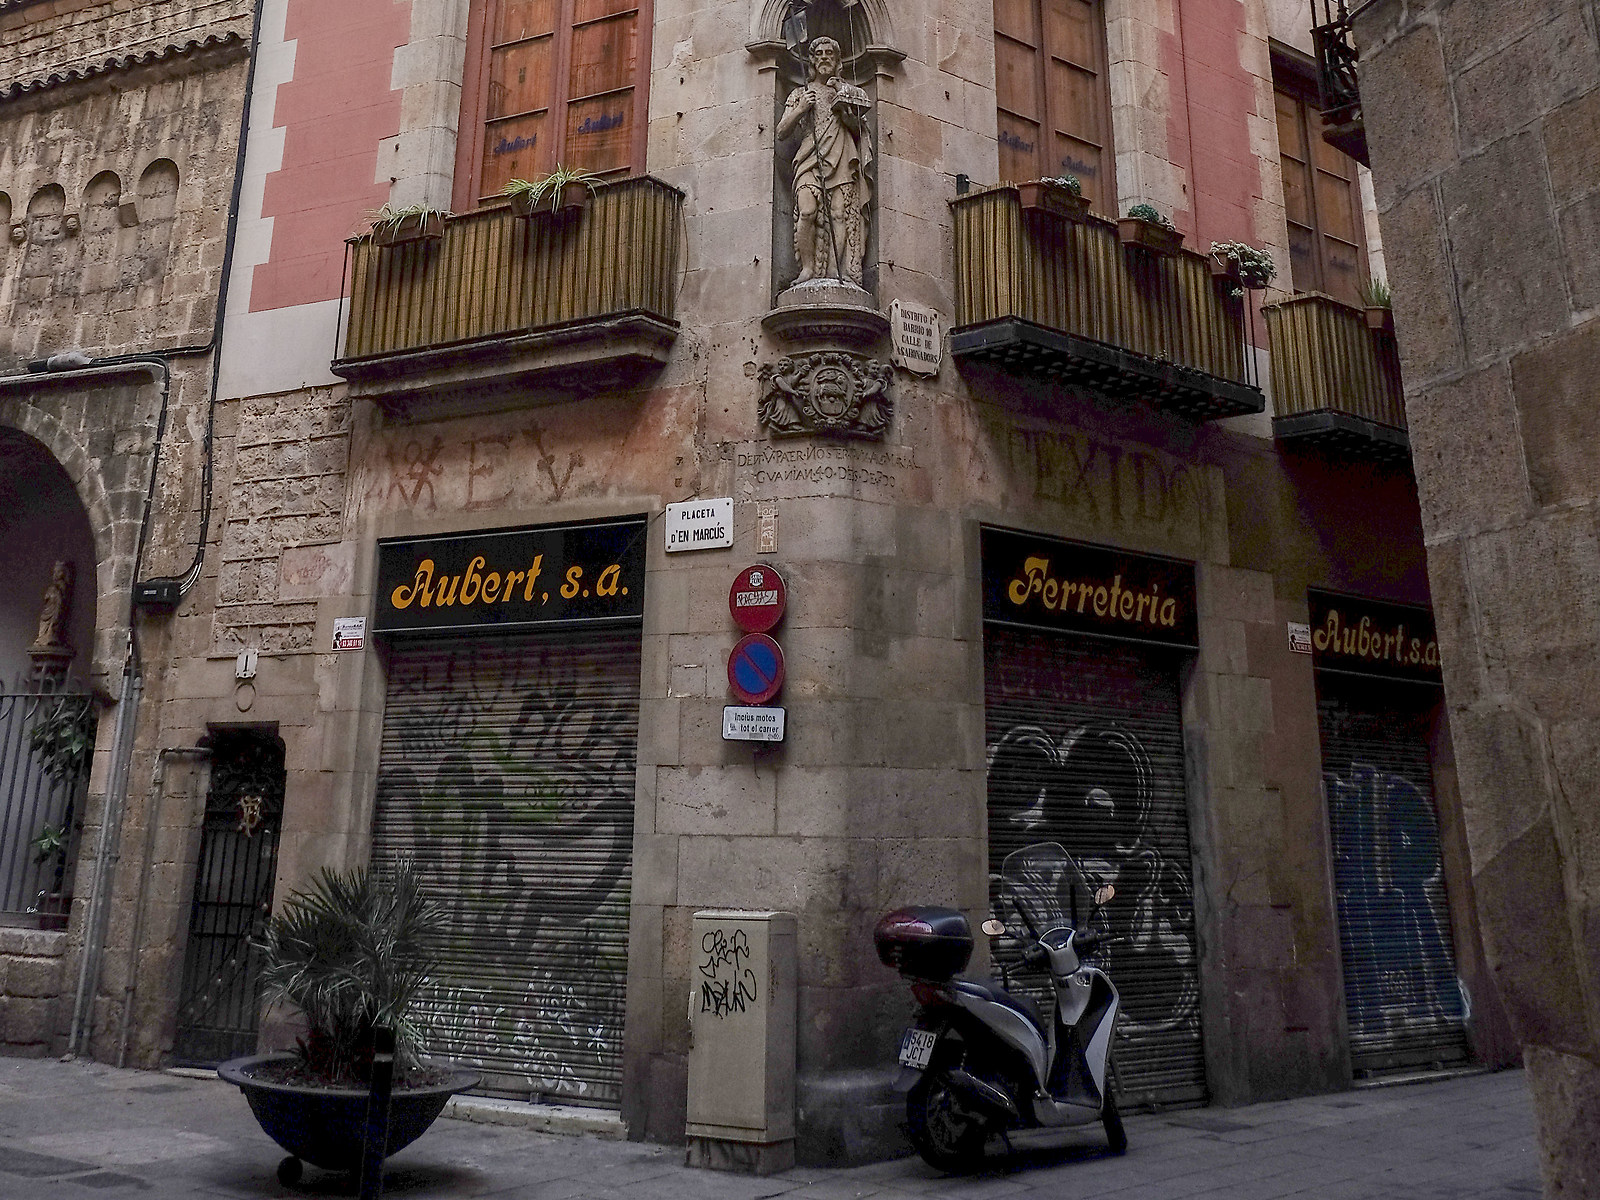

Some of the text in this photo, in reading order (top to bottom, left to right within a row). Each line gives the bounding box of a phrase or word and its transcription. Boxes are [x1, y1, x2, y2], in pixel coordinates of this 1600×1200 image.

[900, 308, 928, 324] DISTRITO
[903, 321, 925, 336] BARRIO
[901, 334, 933, 351] CALLE DE
[681, 508, 715, 520] PLACETA
[692, 521, 725, 541] MARCÚS
[560, 563, 629, 599] s.a.
[1008, 556, 1176, 627] Ferreteria
[243, 654, 249, 672] 1
[756, 714, 776, 722] motos
[740, 724, 780, 734] tot el carrer
[911, 1031, 934, 1049] 5418
[906, 1045, 925, 1062] JCT
